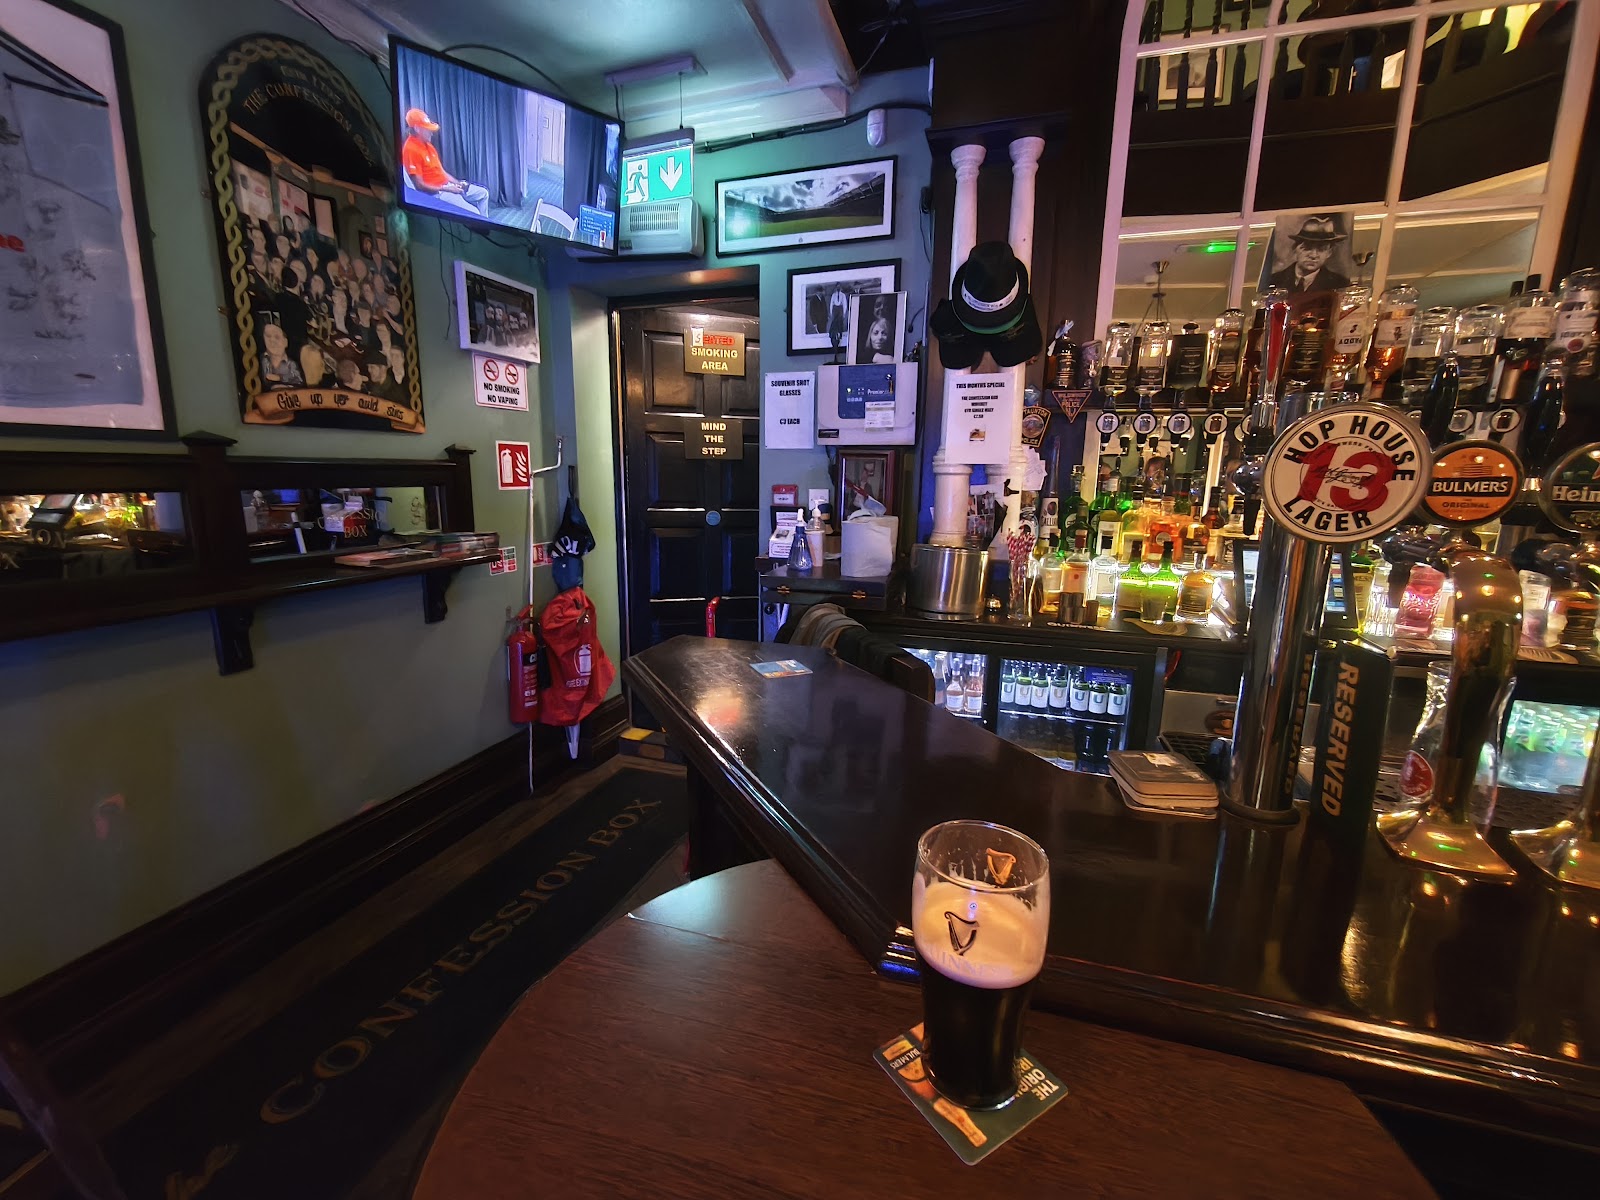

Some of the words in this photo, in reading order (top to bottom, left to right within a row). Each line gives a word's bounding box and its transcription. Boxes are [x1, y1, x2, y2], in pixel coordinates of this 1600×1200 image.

[243, 88, 268, 115] THE
[691, 347, 738, 359] SMOKING
[701, 361, 728, 371] AREA
[483, 382, 493, 391] NO
[494, 383, 520, 395] SMOKING
[796, 379, 810, 387] SHOT
[277, 393, 302, 411] Give
[310, 394, 323, 407] up
[487, 394, 497, 403] NO
[497, 396, 519, 405] VAPING
[1023, 407, 1049, 418] TAUNTON
[701, 422, 727, 431] MIND
[704, 435, 724, 443] THE
[702, 447, 727, 456] STEP
[1283, 419, 1335, 465] HOP
[1350, 415, 1416, 481] HOUSE
[1297, 441, 1399, 513] 13
[1432, 481, 1509, 493] BULMERS
[1442, 501, 1491, 509] ORIGINAL
[1283, 495, 1372, 532] LAGER
[344, 524, 368, 539] BOX
[1321, 661, 1360, 818] RESERVED
[258, 850, 598, 1126] CONFESSION
[587, 797, 663, 849] BOX
[890, 1048, 921, 1070] BULMERS
[1032, 1079, 1060, 1101] THE
